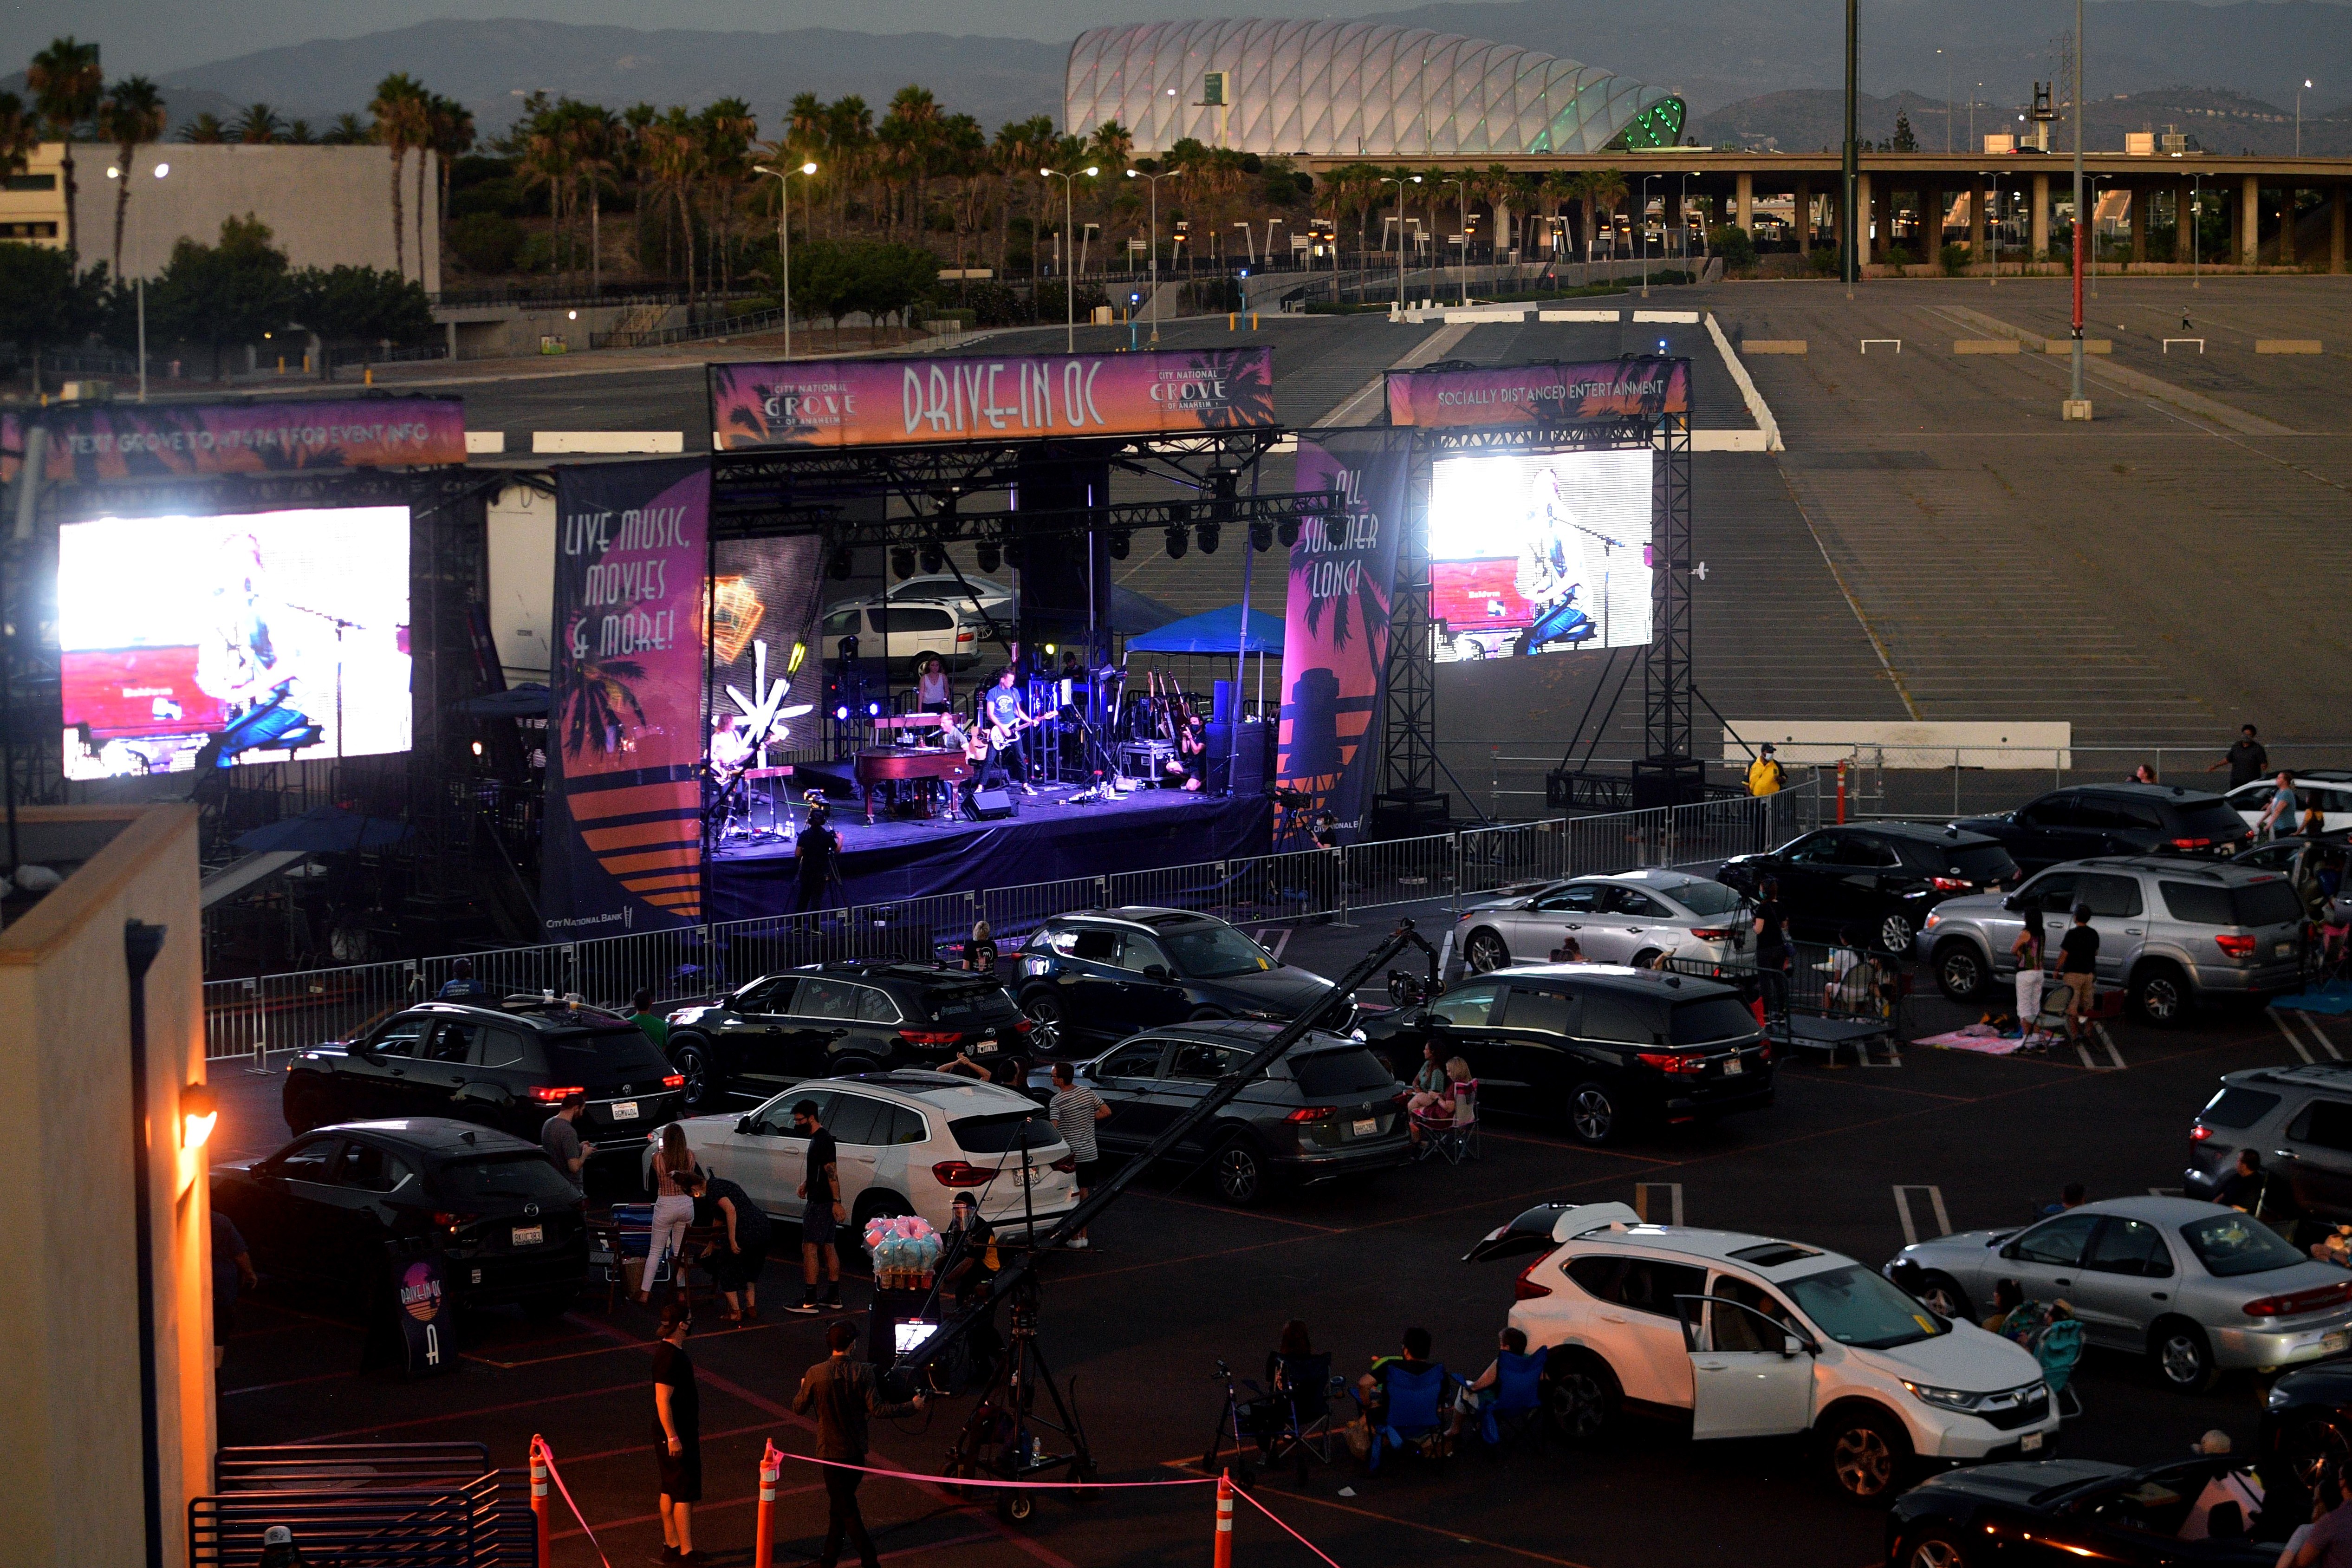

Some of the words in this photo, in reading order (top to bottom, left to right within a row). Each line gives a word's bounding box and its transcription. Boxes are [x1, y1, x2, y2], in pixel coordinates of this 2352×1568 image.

[774, 385, 794, 394] CITY
[798, 383, 847, 393] NATIONAL
[1150, 381, 1226, 401] GROVE
[1158, 371, 1173, 380] CITY
[1176, 370, 1217, 379] NATIONAL
[764, 395, 857, 417] GROVE
[903, 361, 1053, 435] DRIVE-IN
[1064, 360, 1105, 427] OC
[1438, 388, 1498, 406] SOCIALLY
[1501, 386, 1566, 403] DISTANCED
[1569, 380, 1664, 399] ENTERTAINMENT
[68, 433, 113, 455] TEXT
[117, 431, 184, 453] GROVE
[186, 430, 215, 450] TO
[289, 426, 327, 445] FOR
[329, 423, 383, 444] EVENT
[1335, 470, 1361, 505] ALL
[565, 512, 612, 556] LIVE
[585, 560, 667, 606] MOVIES
[1312, 560, 1362, 598] LONG!
[600, 610, 675, 657] MORE!
[546, 919, 563, 928] CITY
[563, 916, 601, 927] NATIONAL
[601, 913, 623, 922] BANK
[433, 1280, 442, 1296] OC
[425, 1323, 439, 1366] A
